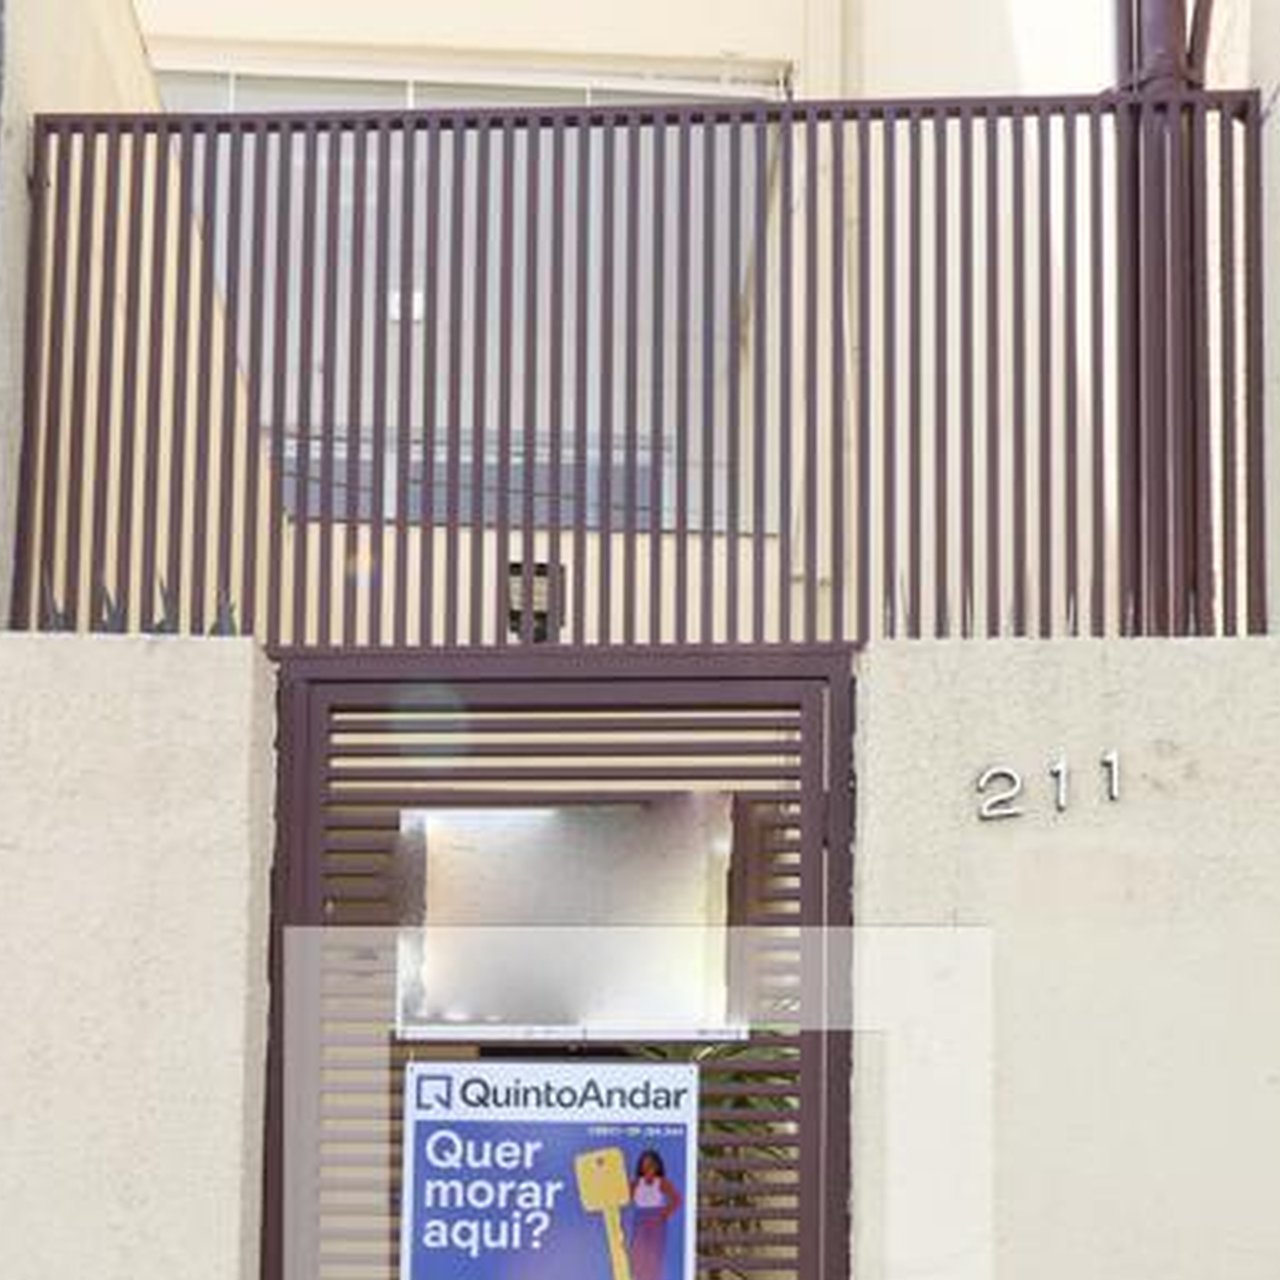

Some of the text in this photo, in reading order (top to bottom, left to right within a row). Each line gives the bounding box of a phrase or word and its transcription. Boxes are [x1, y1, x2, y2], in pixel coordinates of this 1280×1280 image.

[976, 750, 1119, 821] 211
[460, 1078, 688, 1110] QuintoAndar
[425, 1129, 543, 1169] Quer
[424, 1179, 564, 1209] morar
[422, 1210, 551, 1258] aqui?
